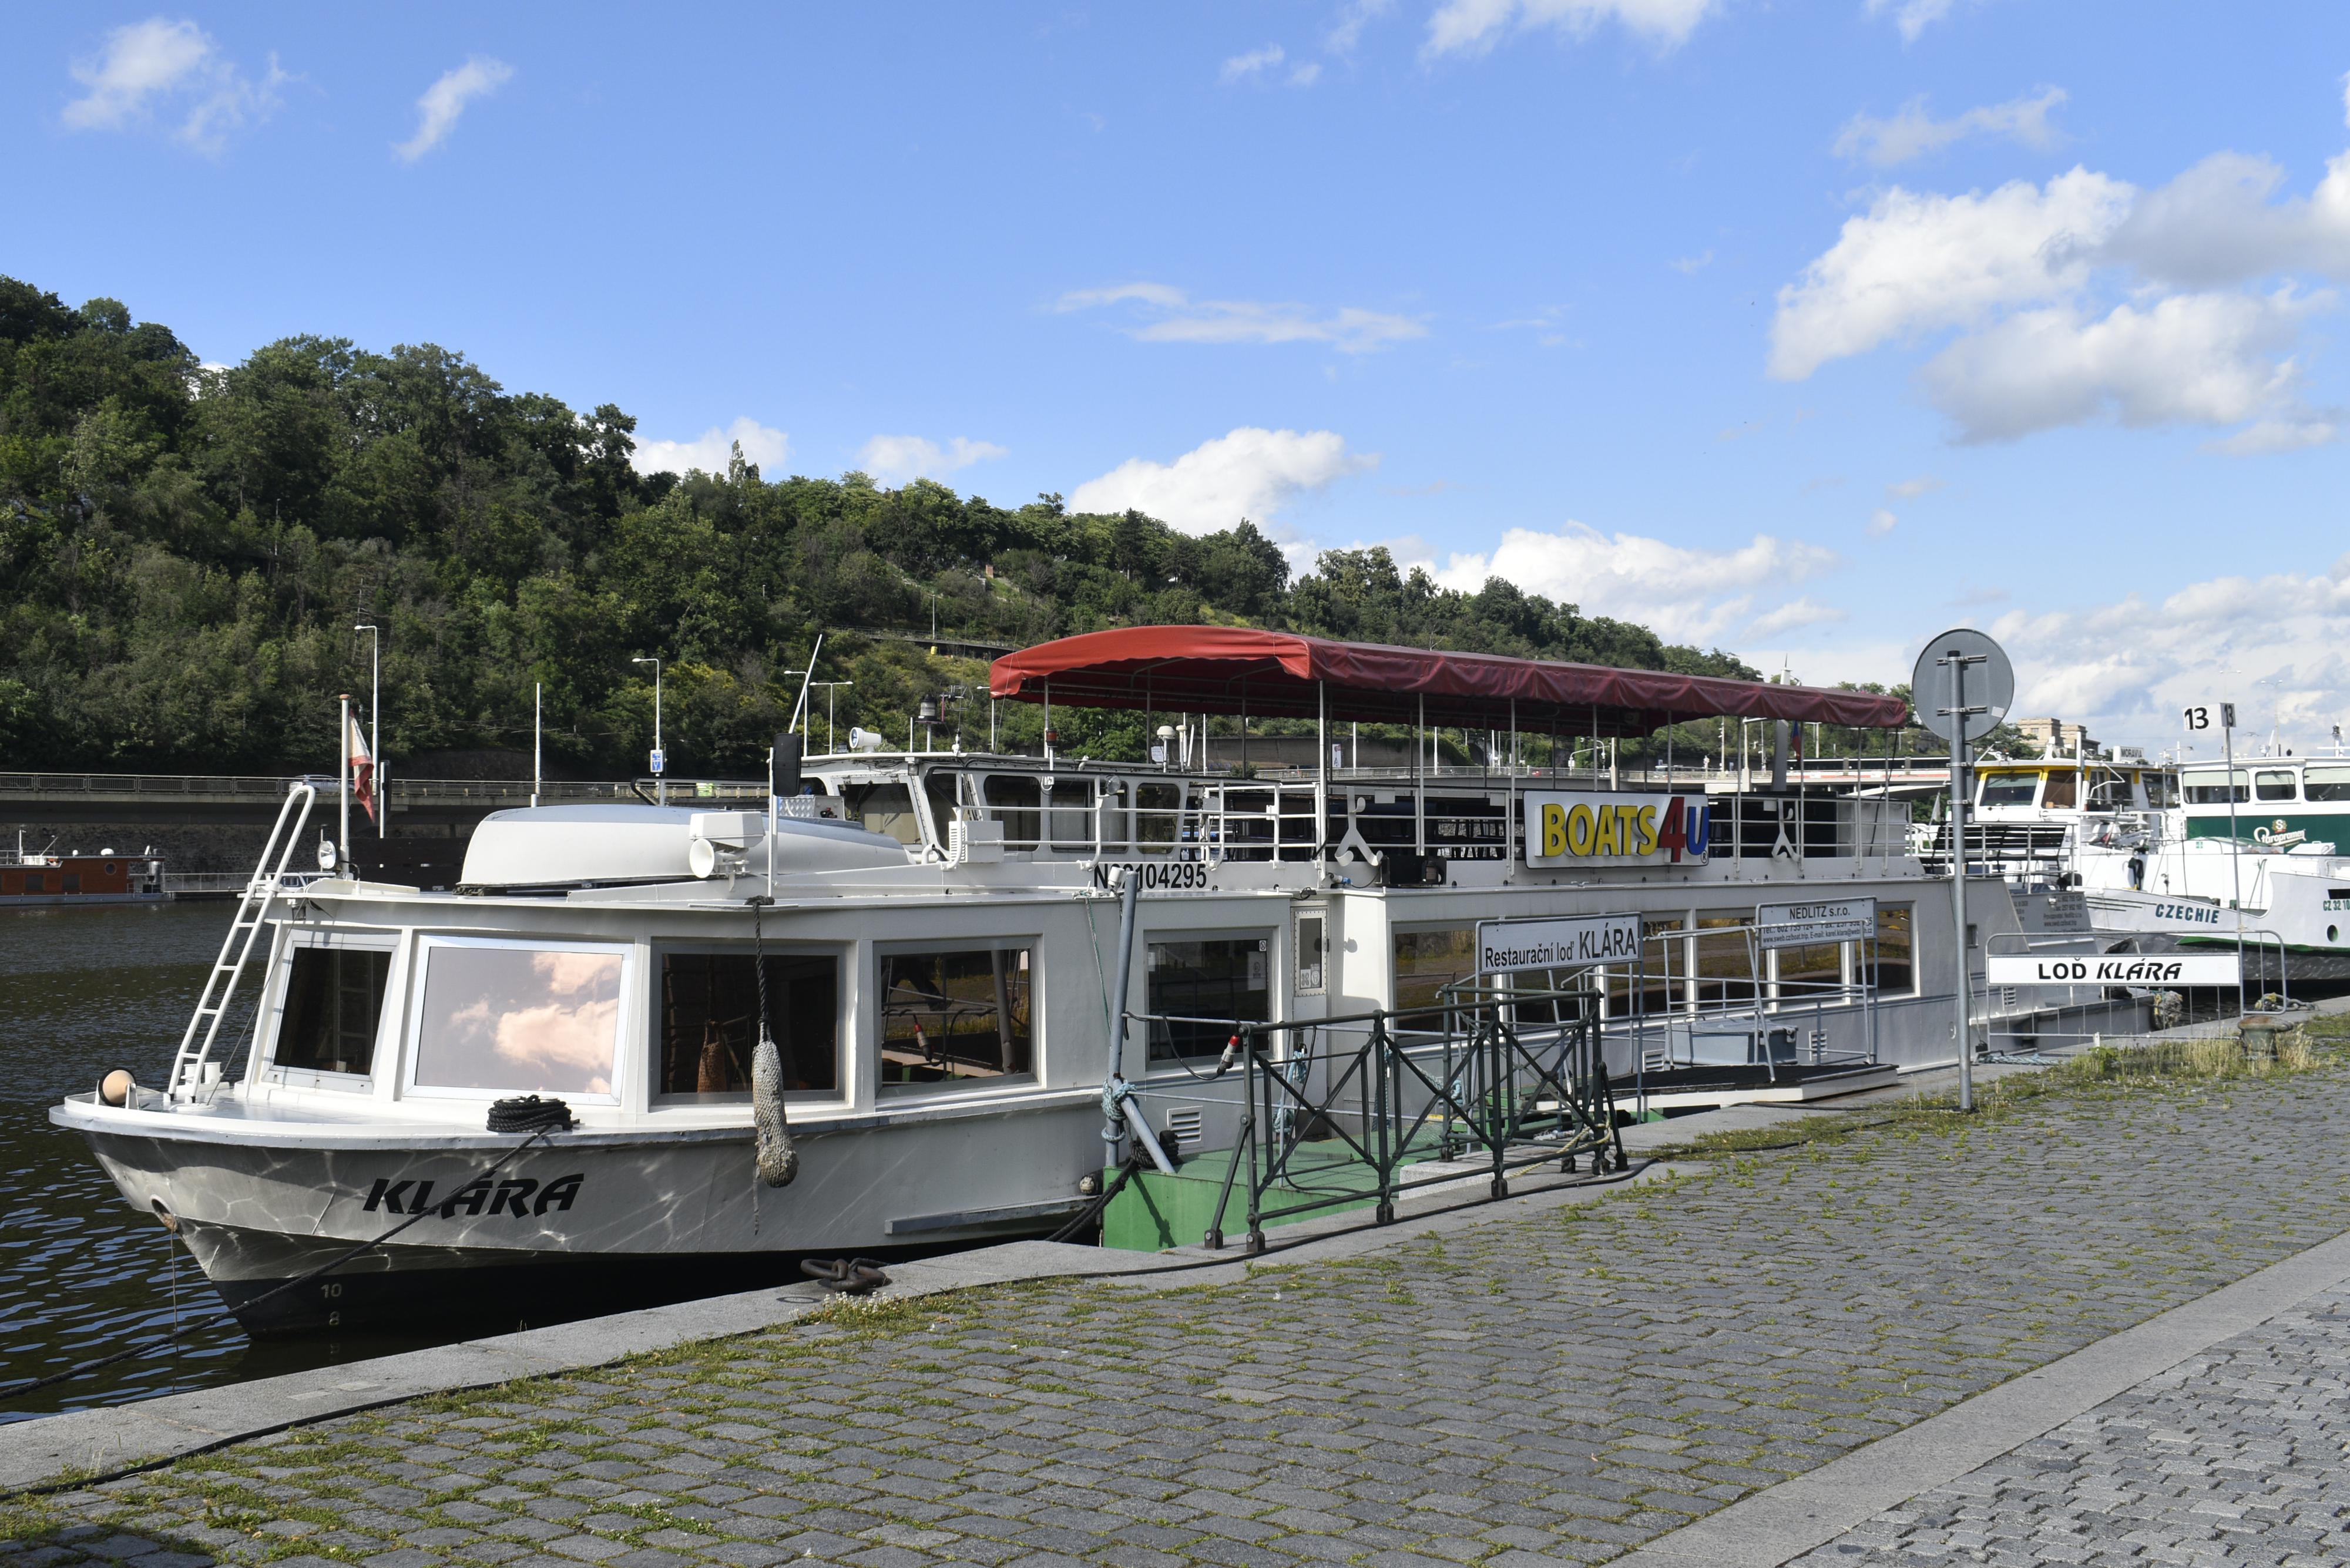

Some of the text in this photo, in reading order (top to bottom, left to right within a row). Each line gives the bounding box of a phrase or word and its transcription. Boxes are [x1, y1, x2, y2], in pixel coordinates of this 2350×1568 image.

[2184, 707, 2209, 730] 13
[2120, 748, 2143, 758] MORAVIA
[1541, 796, 1710, 862] BOATS4U
[1094, 863, 1207, 889] N104295
[1790, 906, 1851, 920] NEDLITZ s.r.o.
[2155, 903, 2220, 924] CZECHIE
[2323, 900, 2331, 911] CZ
[2333, 900, 2341, 911] 32
[1485, 922, 1637, 968] Restaurační loď KLÁRA
[2038, 958, 2182, 981] LOĎ KLÁRA
[320, 1283, 342, 1298] 10
[329, 1311, 340, 1325] 8
